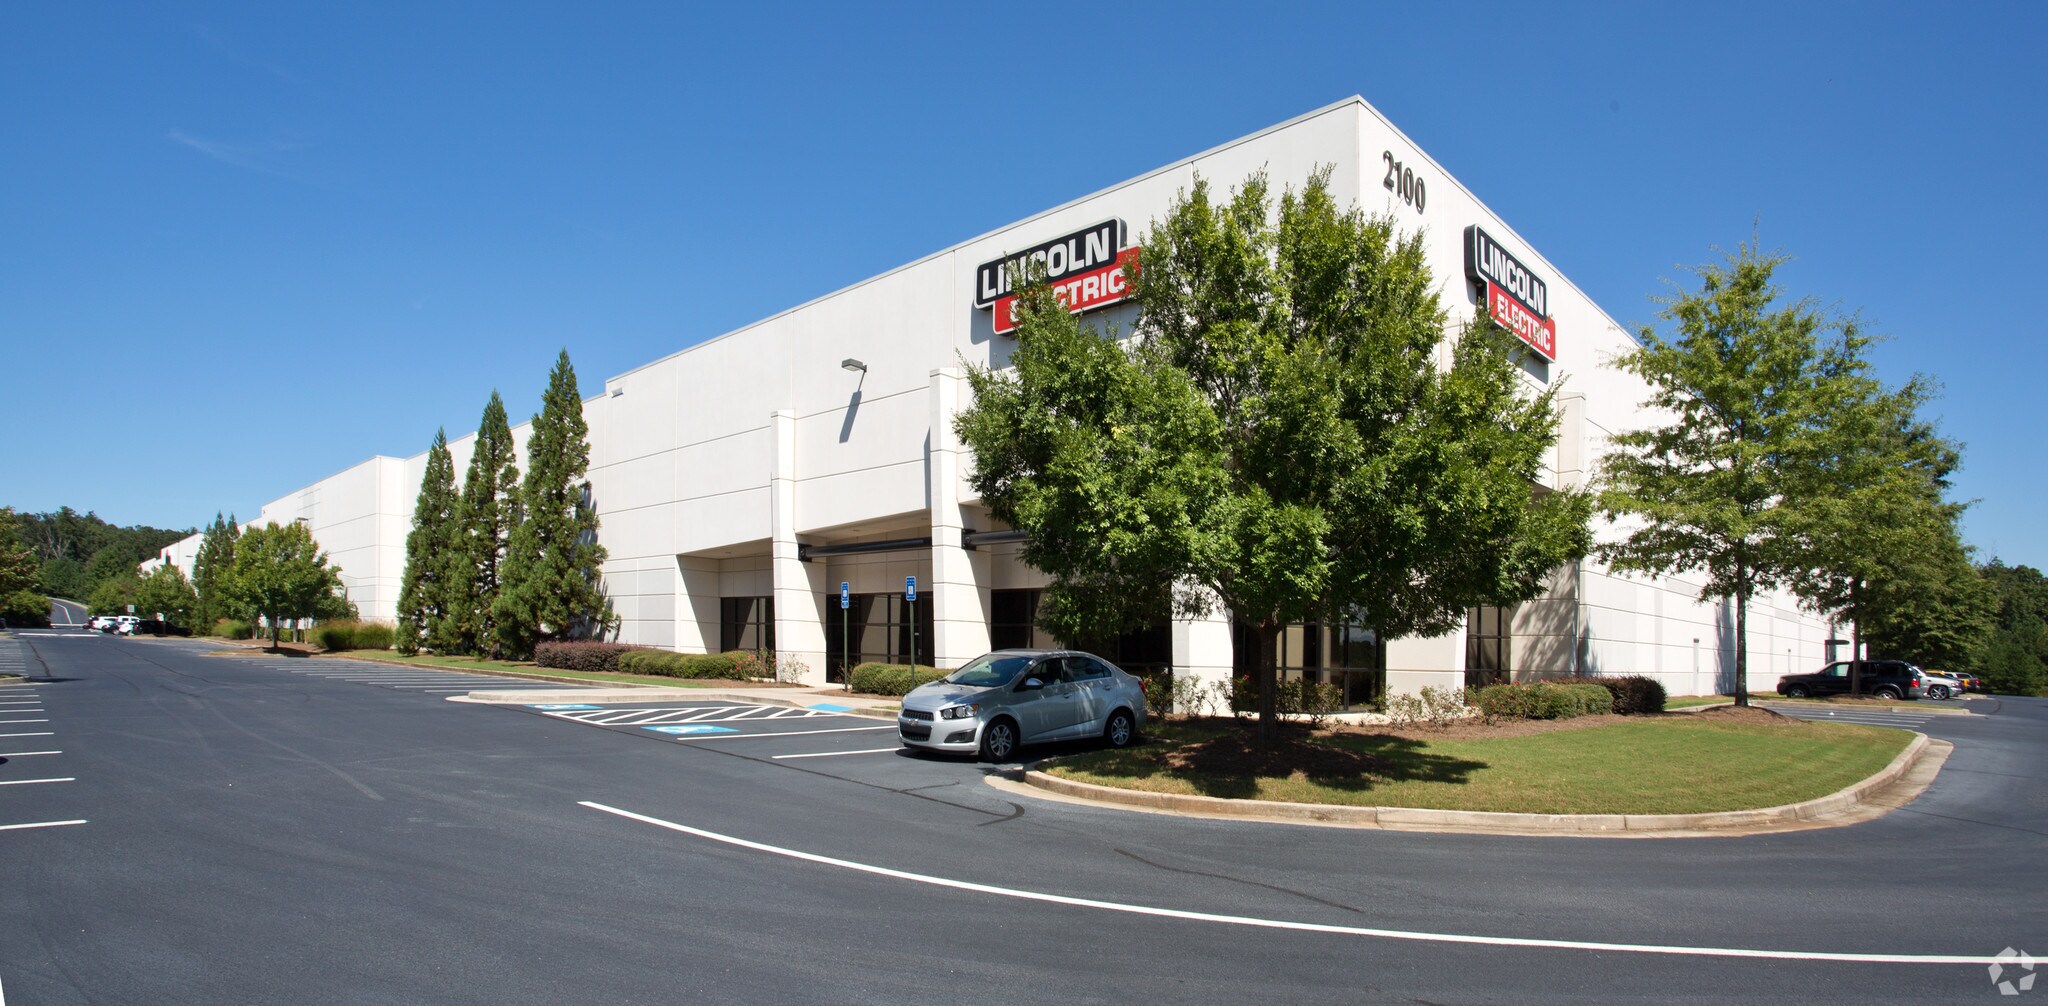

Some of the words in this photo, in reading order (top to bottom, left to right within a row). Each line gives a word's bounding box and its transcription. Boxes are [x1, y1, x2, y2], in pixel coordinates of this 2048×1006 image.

[1383, 150, 1426, 215] 2100
[982, 227, 1110, 300] LINCOLN
[1009, 267, 1126, 323] ECTRIC
[1479, 235, 1545, 317] LINCOLN
[1497, 292, 1551, 351] ELECTRIC
